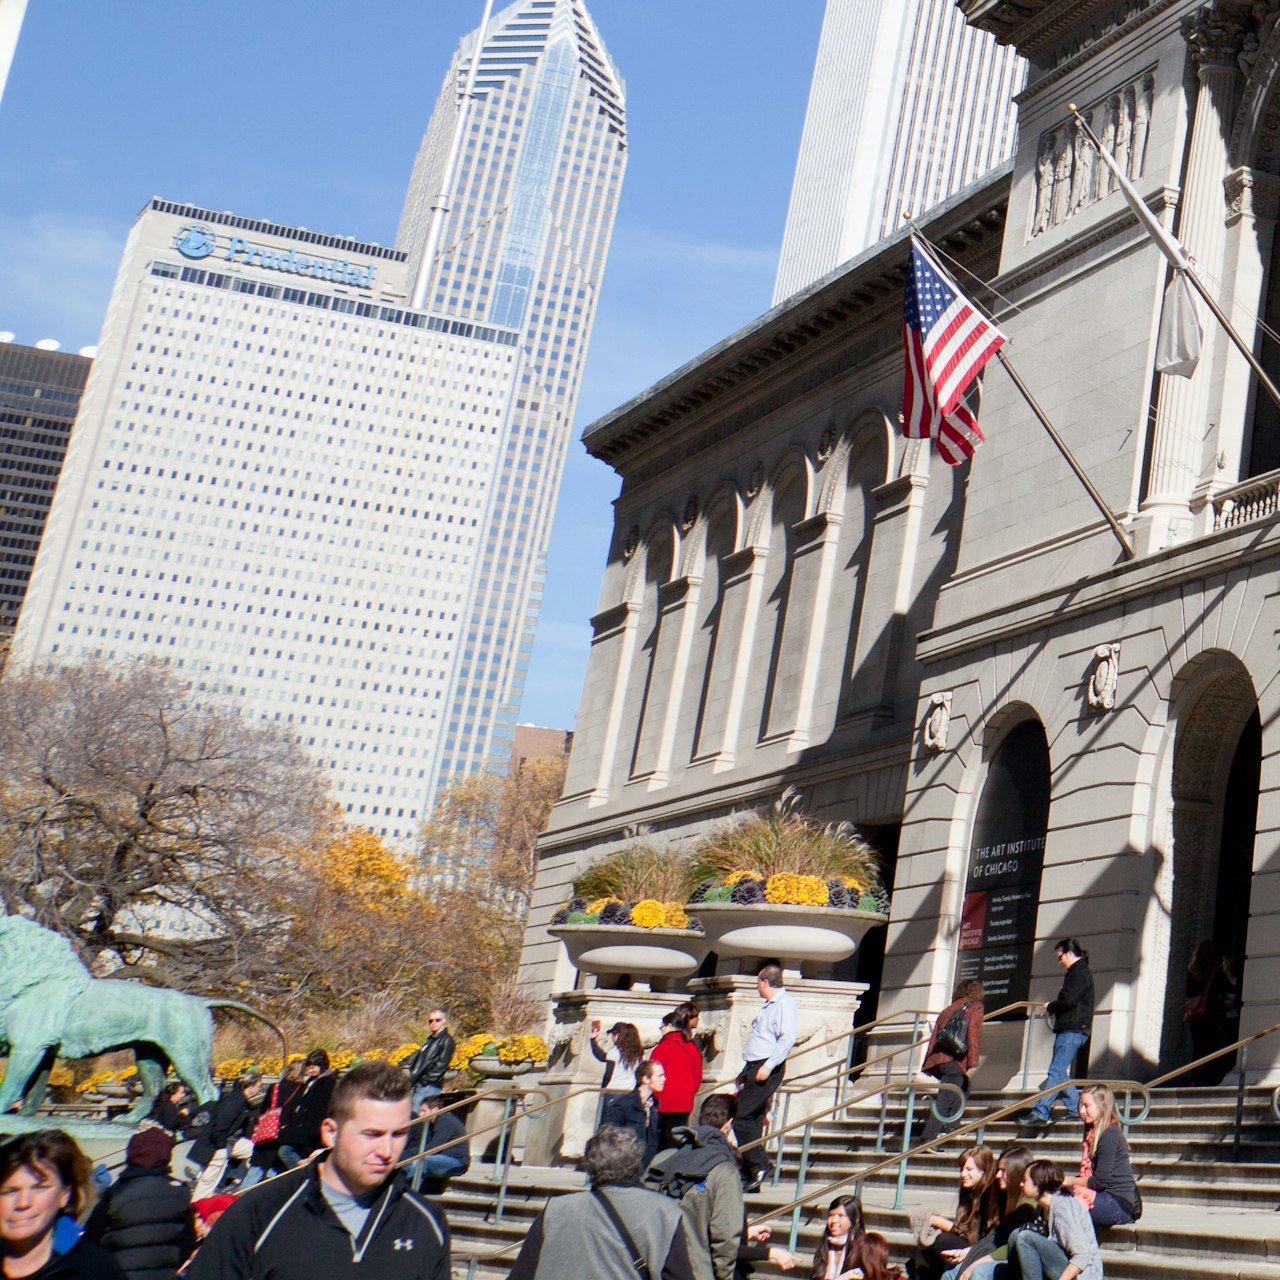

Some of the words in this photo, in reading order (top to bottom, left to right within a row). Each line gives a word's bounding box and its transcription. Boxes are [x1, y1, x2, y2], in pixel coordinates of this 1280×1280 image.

[225, 234, 377, 290] Prudential
[976, 846, 990, 860] THE
[991, 843, 1006, 857] ART
[1007, 836, 1045, 855] INSTITUTE
[973, 865, 983, 878] OF
[984, 860, 1019, 877] CHICAGO
